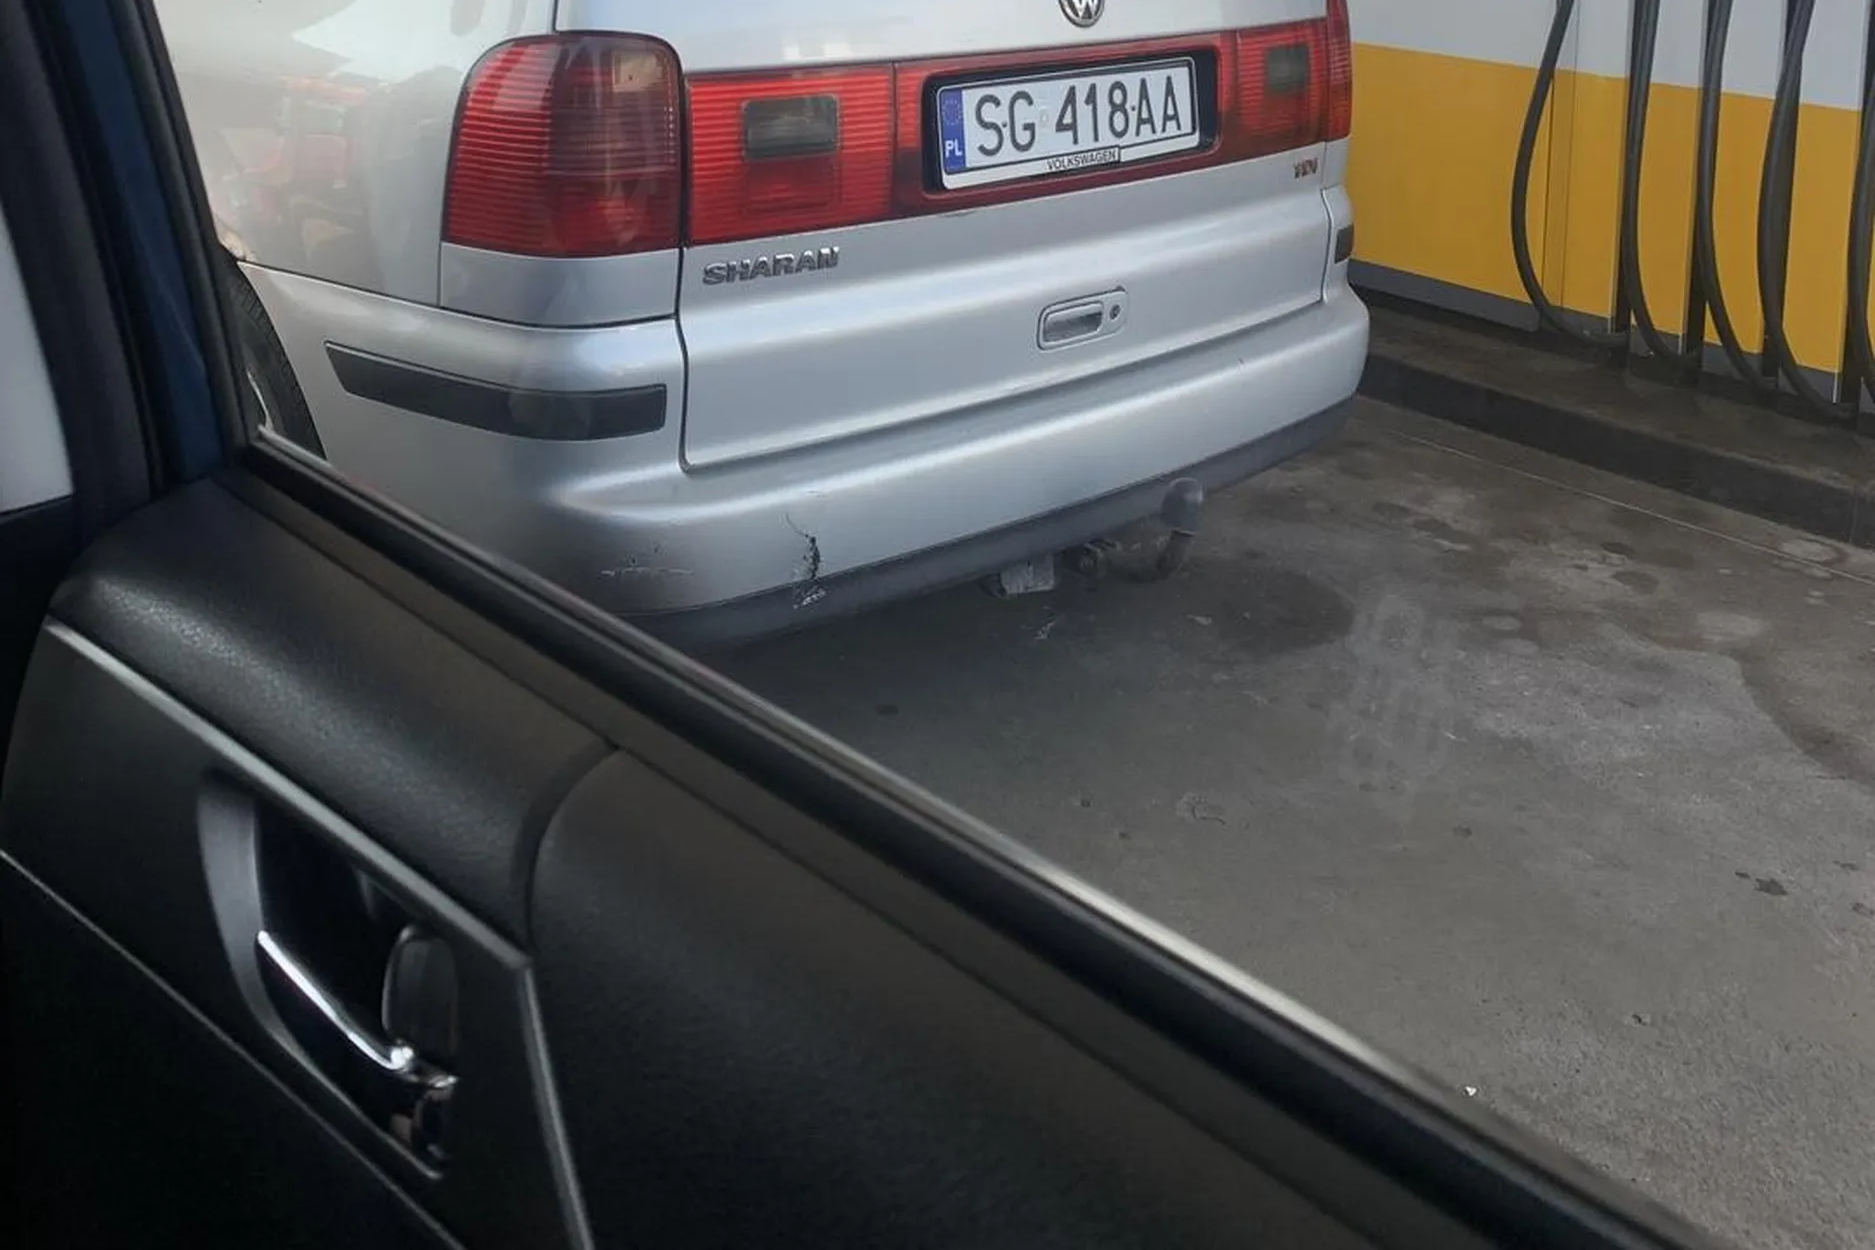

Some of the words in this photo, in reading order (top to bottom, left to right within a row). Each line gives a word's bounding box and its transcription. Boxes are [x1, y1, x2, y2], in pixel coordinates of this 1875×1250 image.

[975, 90, 1036, 157] SG
[1055, 75, 1182, 145] 418AA
[945, 138, 963, 157] PL
[1046, 148, 1118, 171] VOLKSWAGEN
[702, 246, 840, 285] SHARAN
